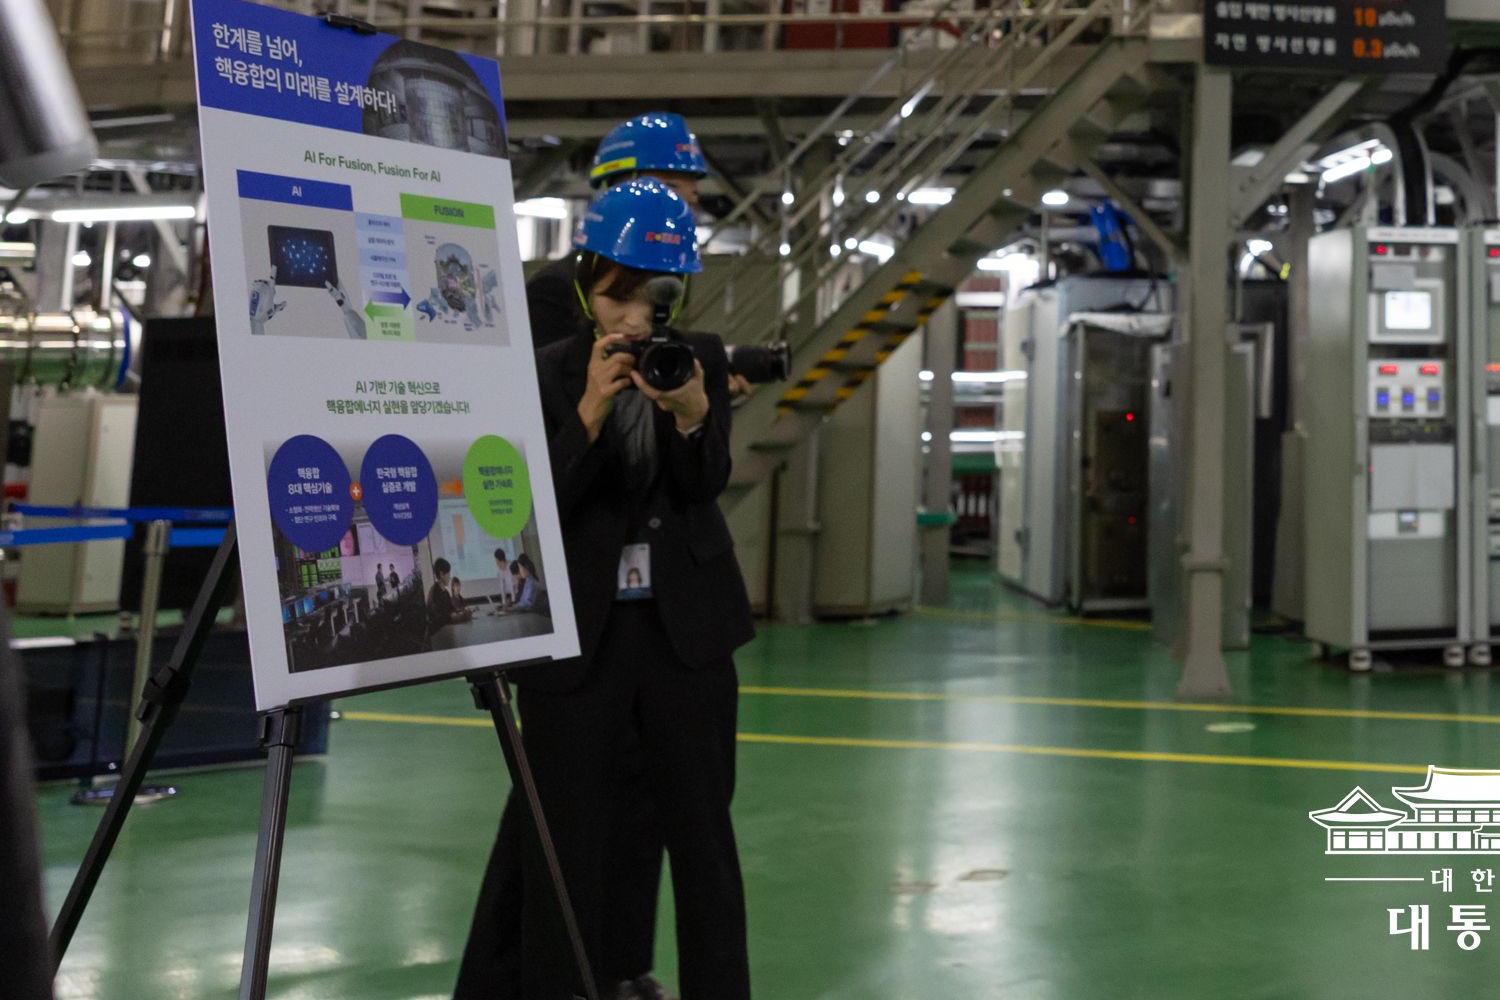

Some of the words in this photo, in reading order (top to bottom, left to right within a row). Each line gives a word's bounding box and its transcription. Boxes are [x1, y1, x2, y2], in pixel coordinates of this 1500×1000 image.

[211, 22, 263, 57] 한계를
[266, 34, 303, 68] 넘어,
[214, 56, 282, 93] 핵융합의
[285, 71, 332, 102] 미래를
[334, 81, 397, 115] 설계하다!
[304, 150, 317, 163] AI
[319, 152, 337, 167] For
[338, 156, 376, 174] Fusion,
[377, 161, 411, 178] Fusion
[413, 167, 429, 181] For
[430, 170, 441, 183] AI
[291, 184, 303, 198] AI
[355, 380, 367, 394] AI
[369, 380, 387, 395] 기반
[389, 381, 406, 395] 기술
[407, 381, 441, 395] 혁신으로
[326, 399, 382, 415] 핵융합에너지
[383, 400, 409, 415] 실현을
